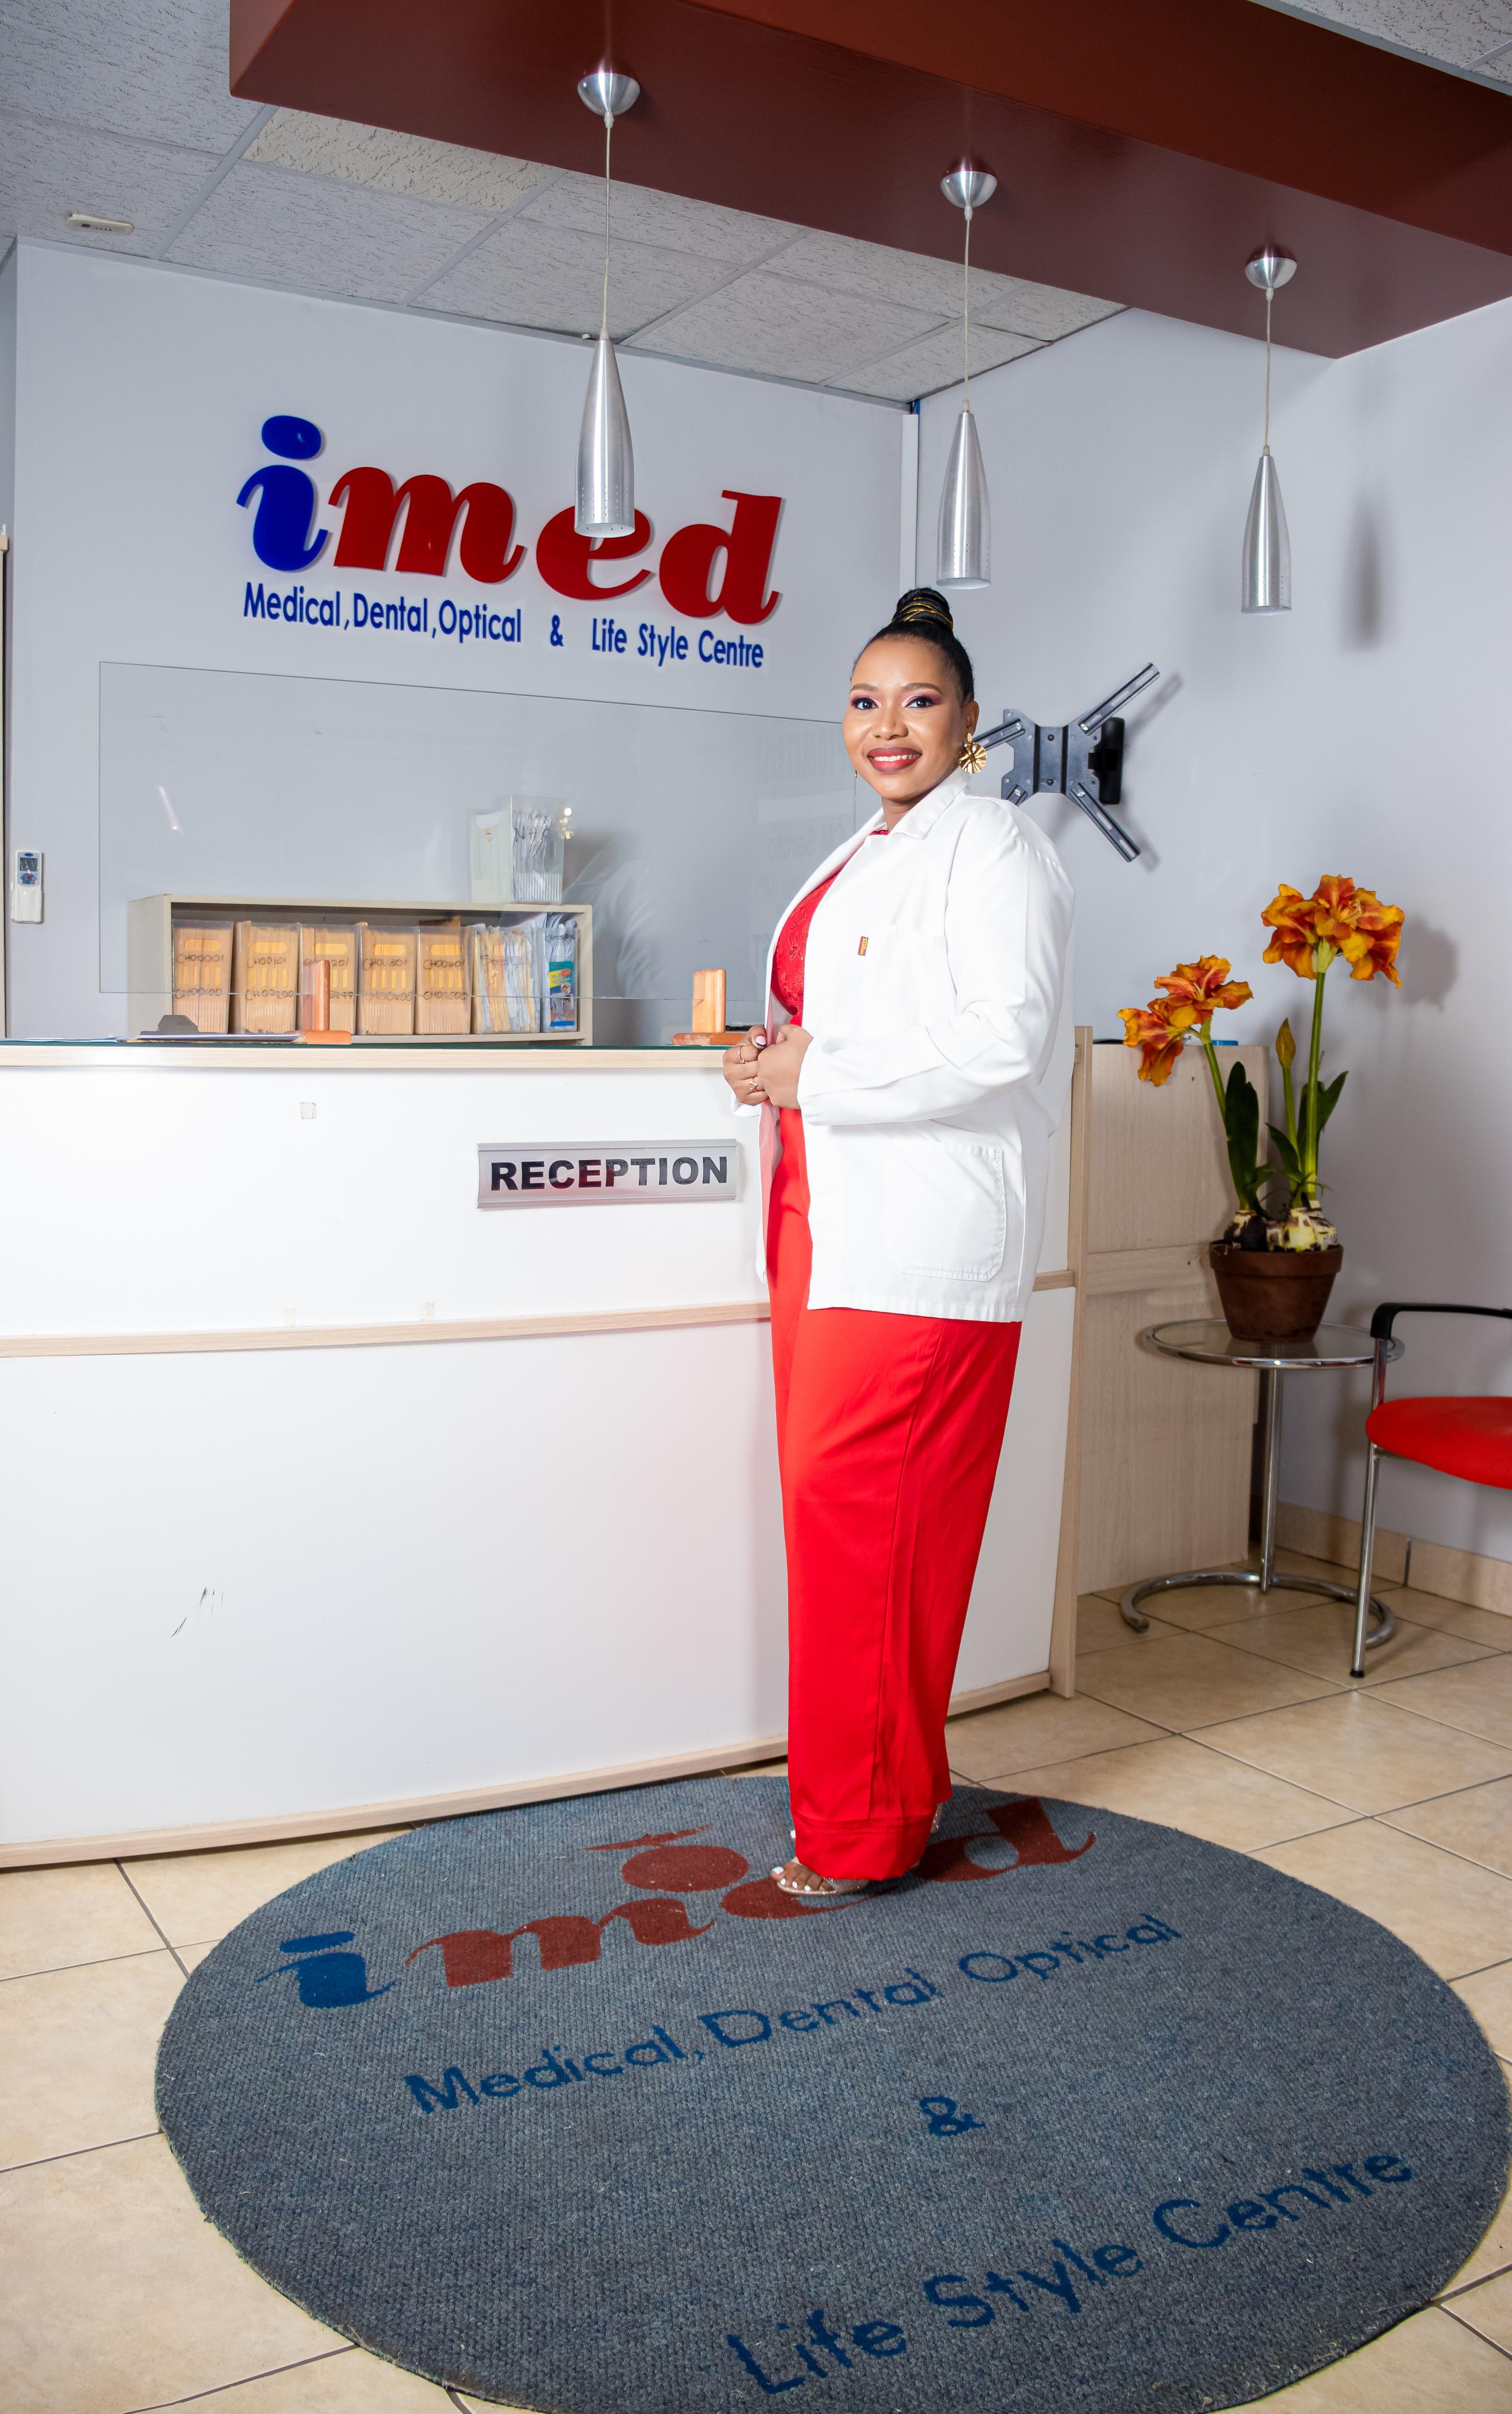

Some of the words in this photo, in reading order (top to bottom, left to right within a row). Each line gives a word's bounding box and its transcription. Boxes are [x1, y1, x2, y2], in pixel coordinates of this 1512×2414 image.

[236, 415, 782, 624] imed
[549, 614, 564, 647] &
[591, 617, 628, 653] Life
[637, 623, 689, 667] Style
[698, 630, 764, 668] Centre
[491, 1157, 727, 1191] RECEPTION
[698, 1967, 938, 2047] Dental
[958, 1914, 1182, 1983] Optical
[918, 2095, 986, 2138] &
[726, 2309, 907, 2394] Life
[923, 2238, 1144, 2328] Style
[1152, 2154, 1412, 2249] Centre
